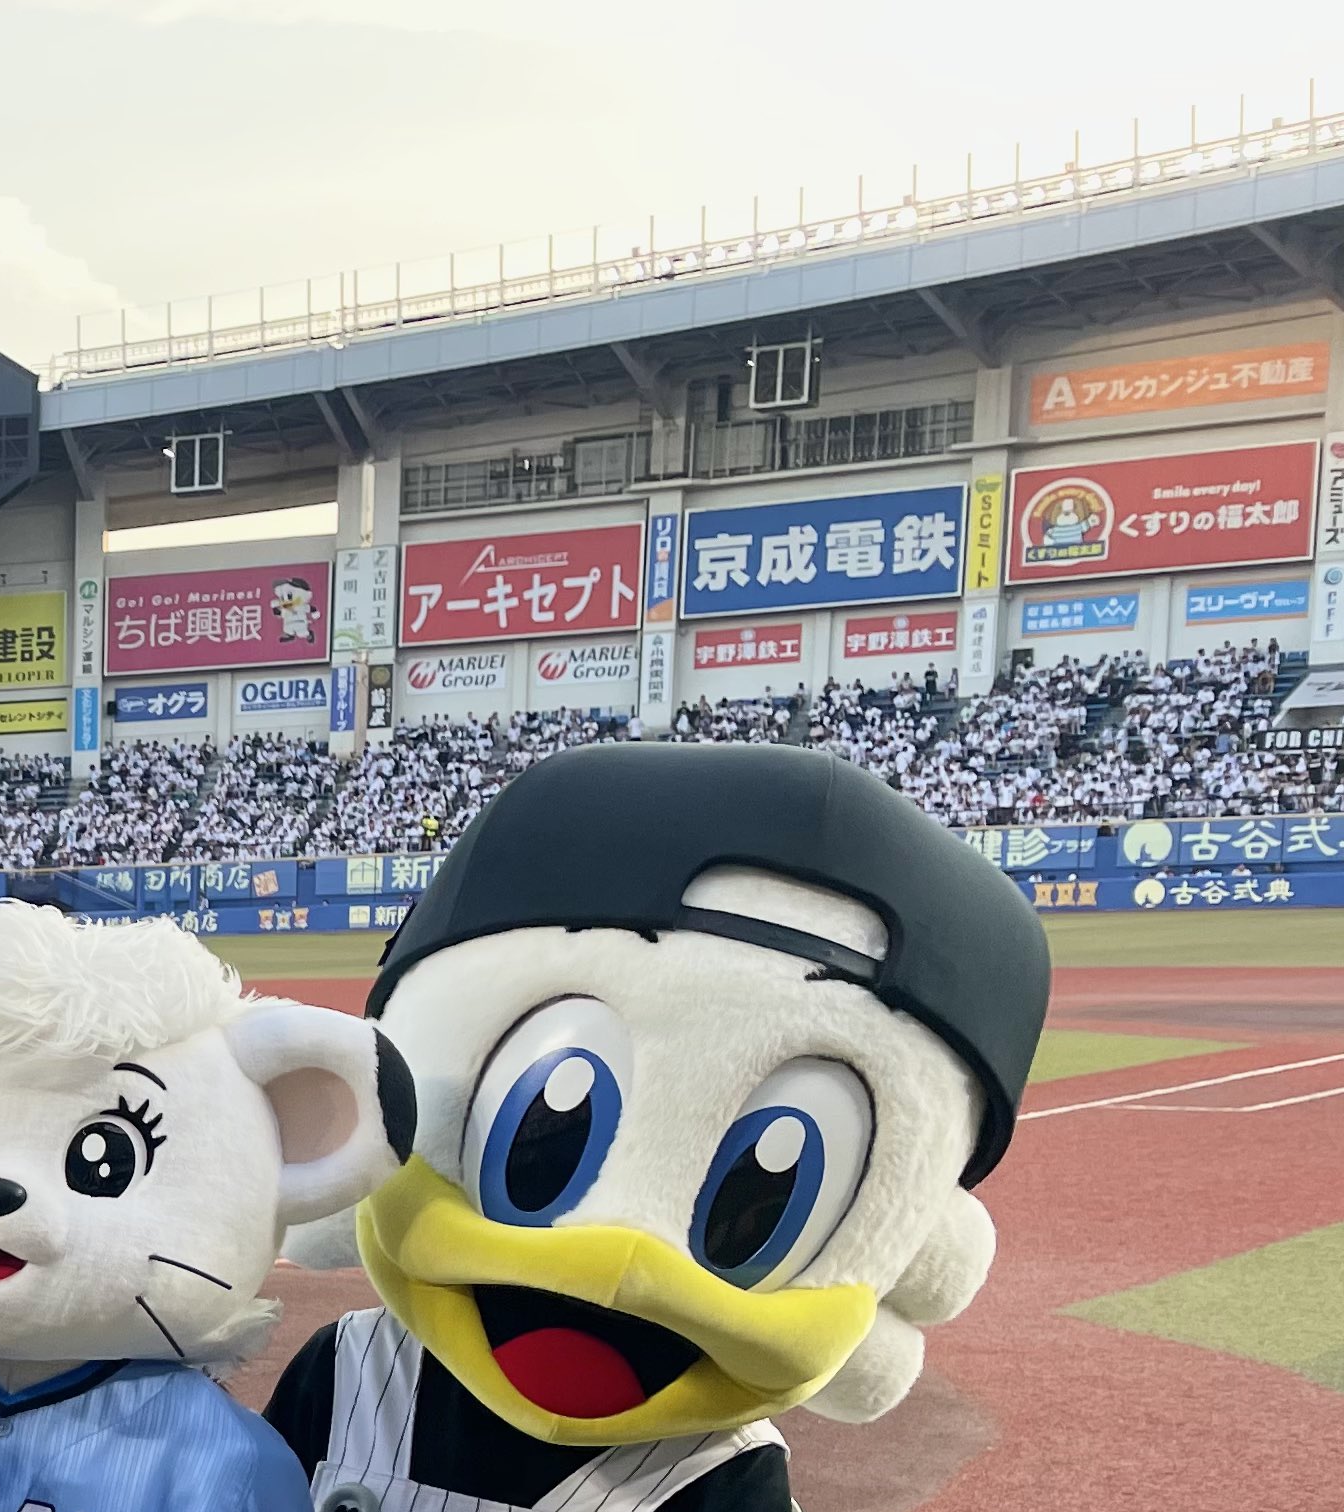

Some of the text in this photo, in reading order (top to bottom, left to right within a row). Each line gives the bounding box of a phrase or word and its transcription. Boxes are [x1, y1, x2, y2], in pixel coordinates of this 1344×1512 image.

[1082, 357, 1315, 405] アルカンジュ不動産
[1192, 483, 1231, 497] every
[1119, 500, 1300, 538] くすりの福太郎
[692, 511, 957, 592] 京成電鉄
[408, 564, 636, 633] アーキセプト
[114, 605, 262, 650] ちば興銀
[436, 654, 506, 672] MARUEI
[573, 663, 631, 680] Group
[241, 678, 327, 703] OGURA
[441, 673, 497, 689] Group
[147, 691, 206, 716] オグラ
[1180, 817, 1344, 864] 古谷式
[1168, 878, 1295, 905] 古谷式典
